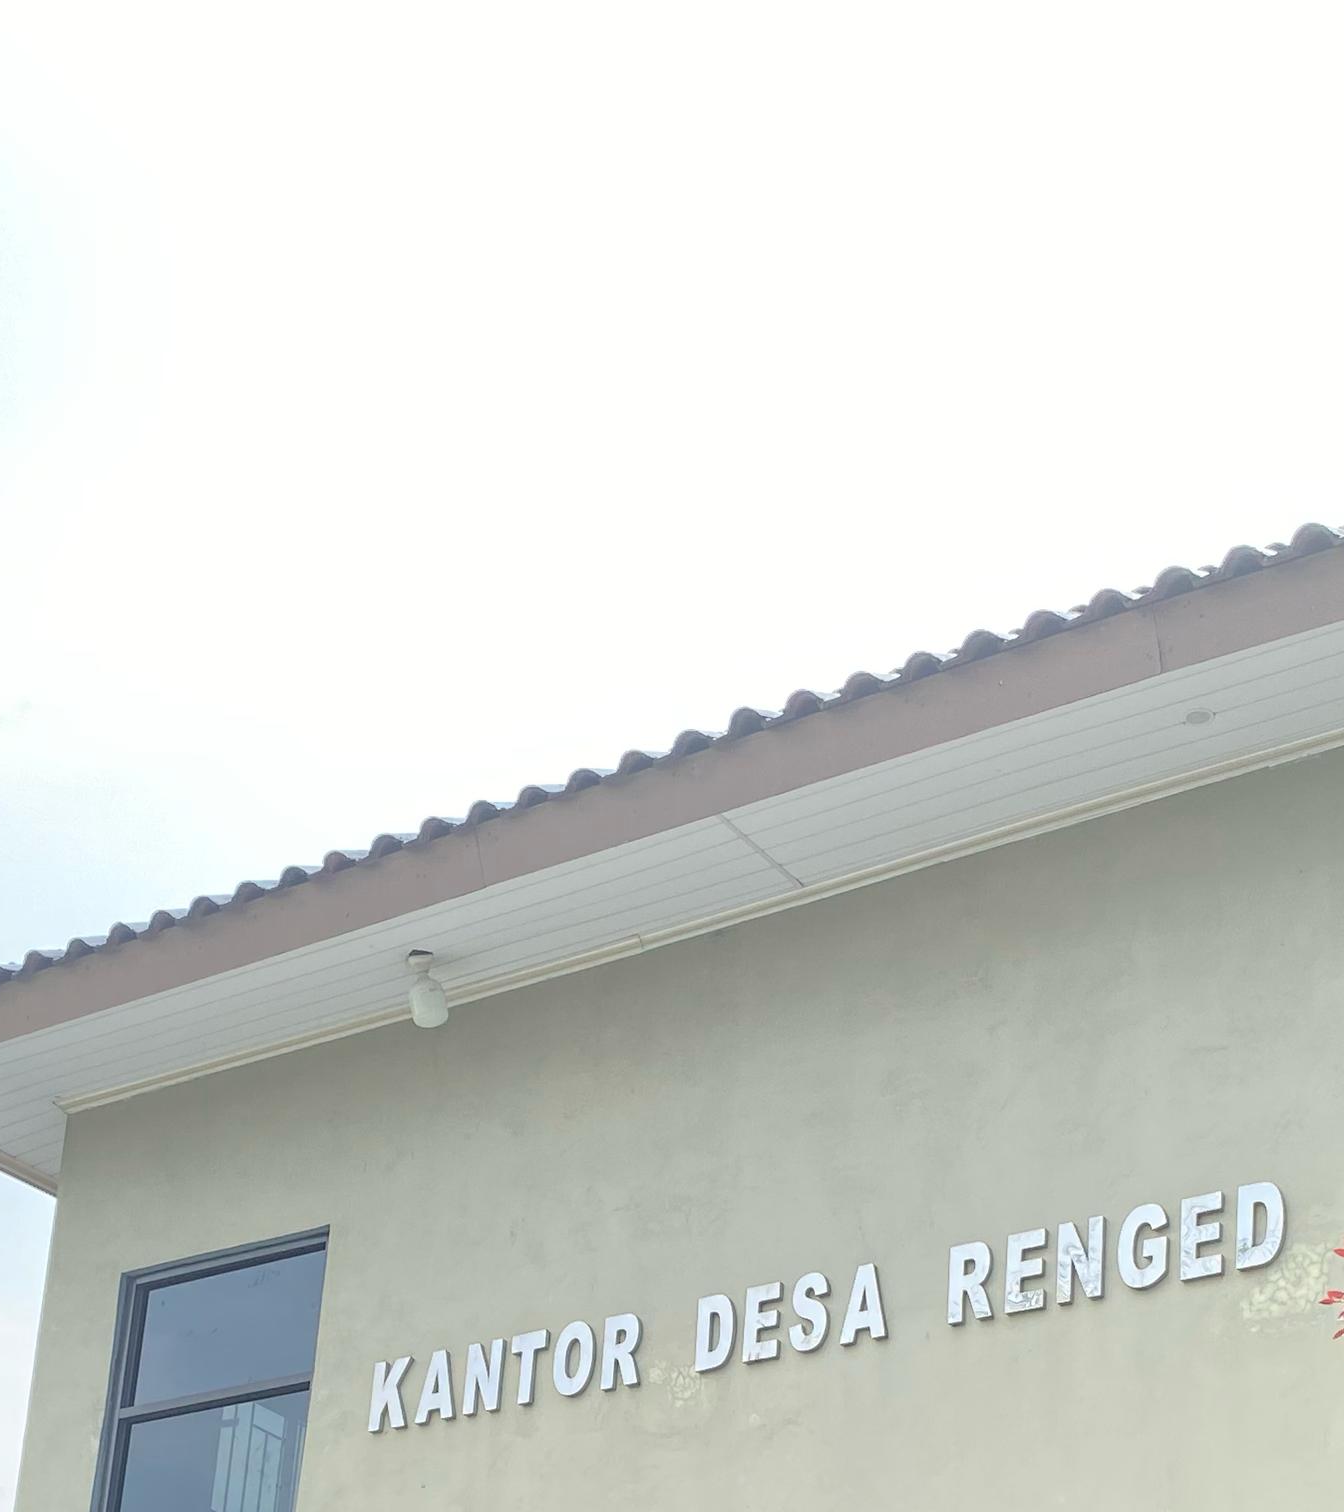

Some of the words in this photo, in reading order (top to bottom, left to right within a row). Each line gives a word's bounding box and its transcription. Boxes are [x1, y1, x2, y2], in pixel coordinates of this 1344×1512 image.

[367, 1312, 643, 1434] KANTOR
[694, 1262, 889, 1373] DESA
[947, 1181, 1288, 1327] RENGED
